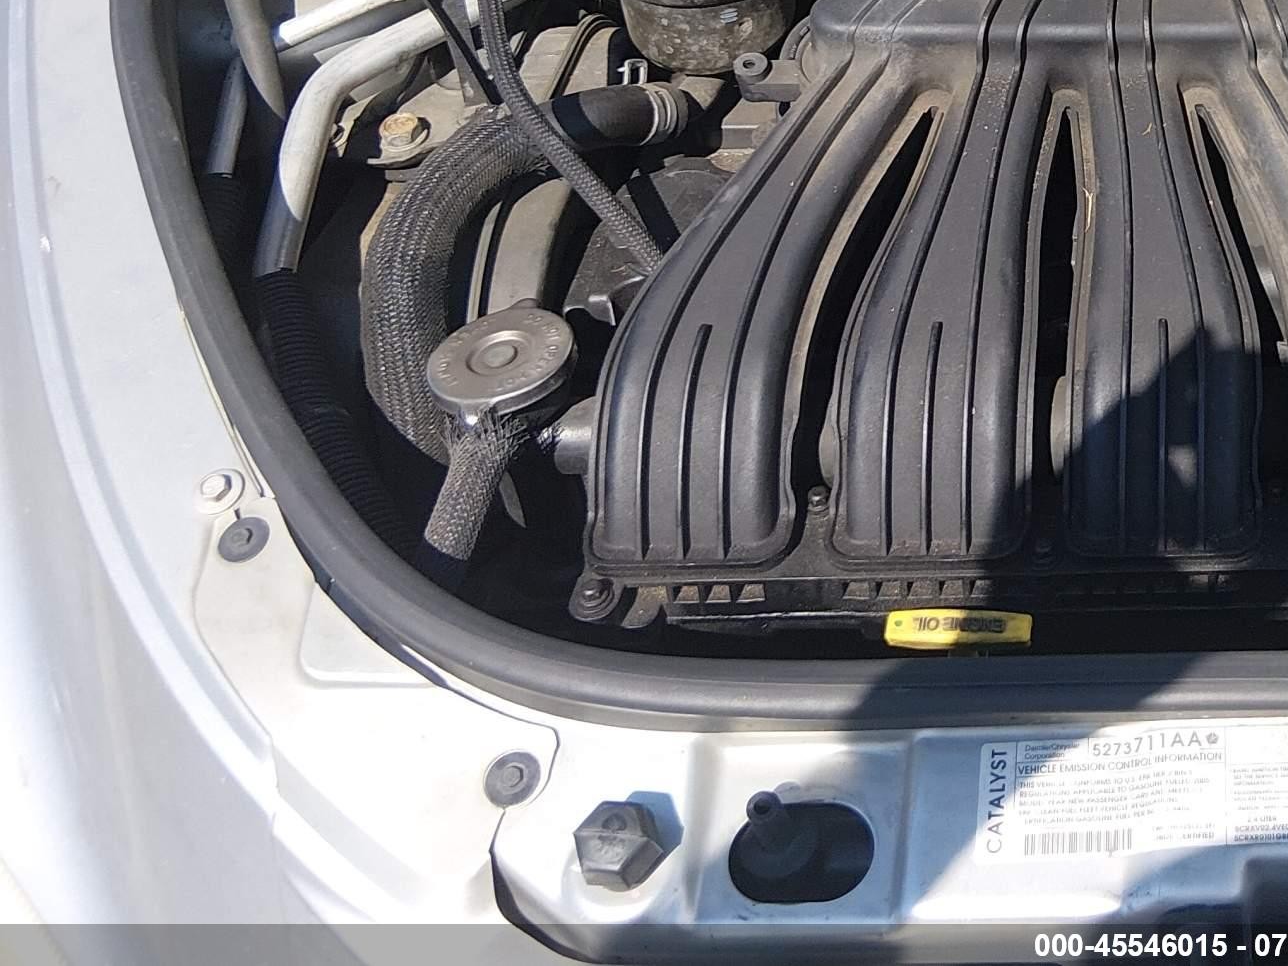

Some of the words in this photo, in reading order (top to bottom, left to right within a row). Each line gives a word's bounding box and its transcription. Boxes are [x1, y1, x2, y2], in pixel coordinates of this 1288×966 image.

[912, 616, 940, 631] OIL
[1092, 732, 1202, 758] 5273711AA
[1018, 764, 1057, 776] VEHICLE
[1060, 762, 1106, 773] EMISSION
[1108, 758, 1152, 772] CONTROL
[1154, 752, 1222, 764] INFORMATION
[986, 748, 1008, 854] CATALYST
